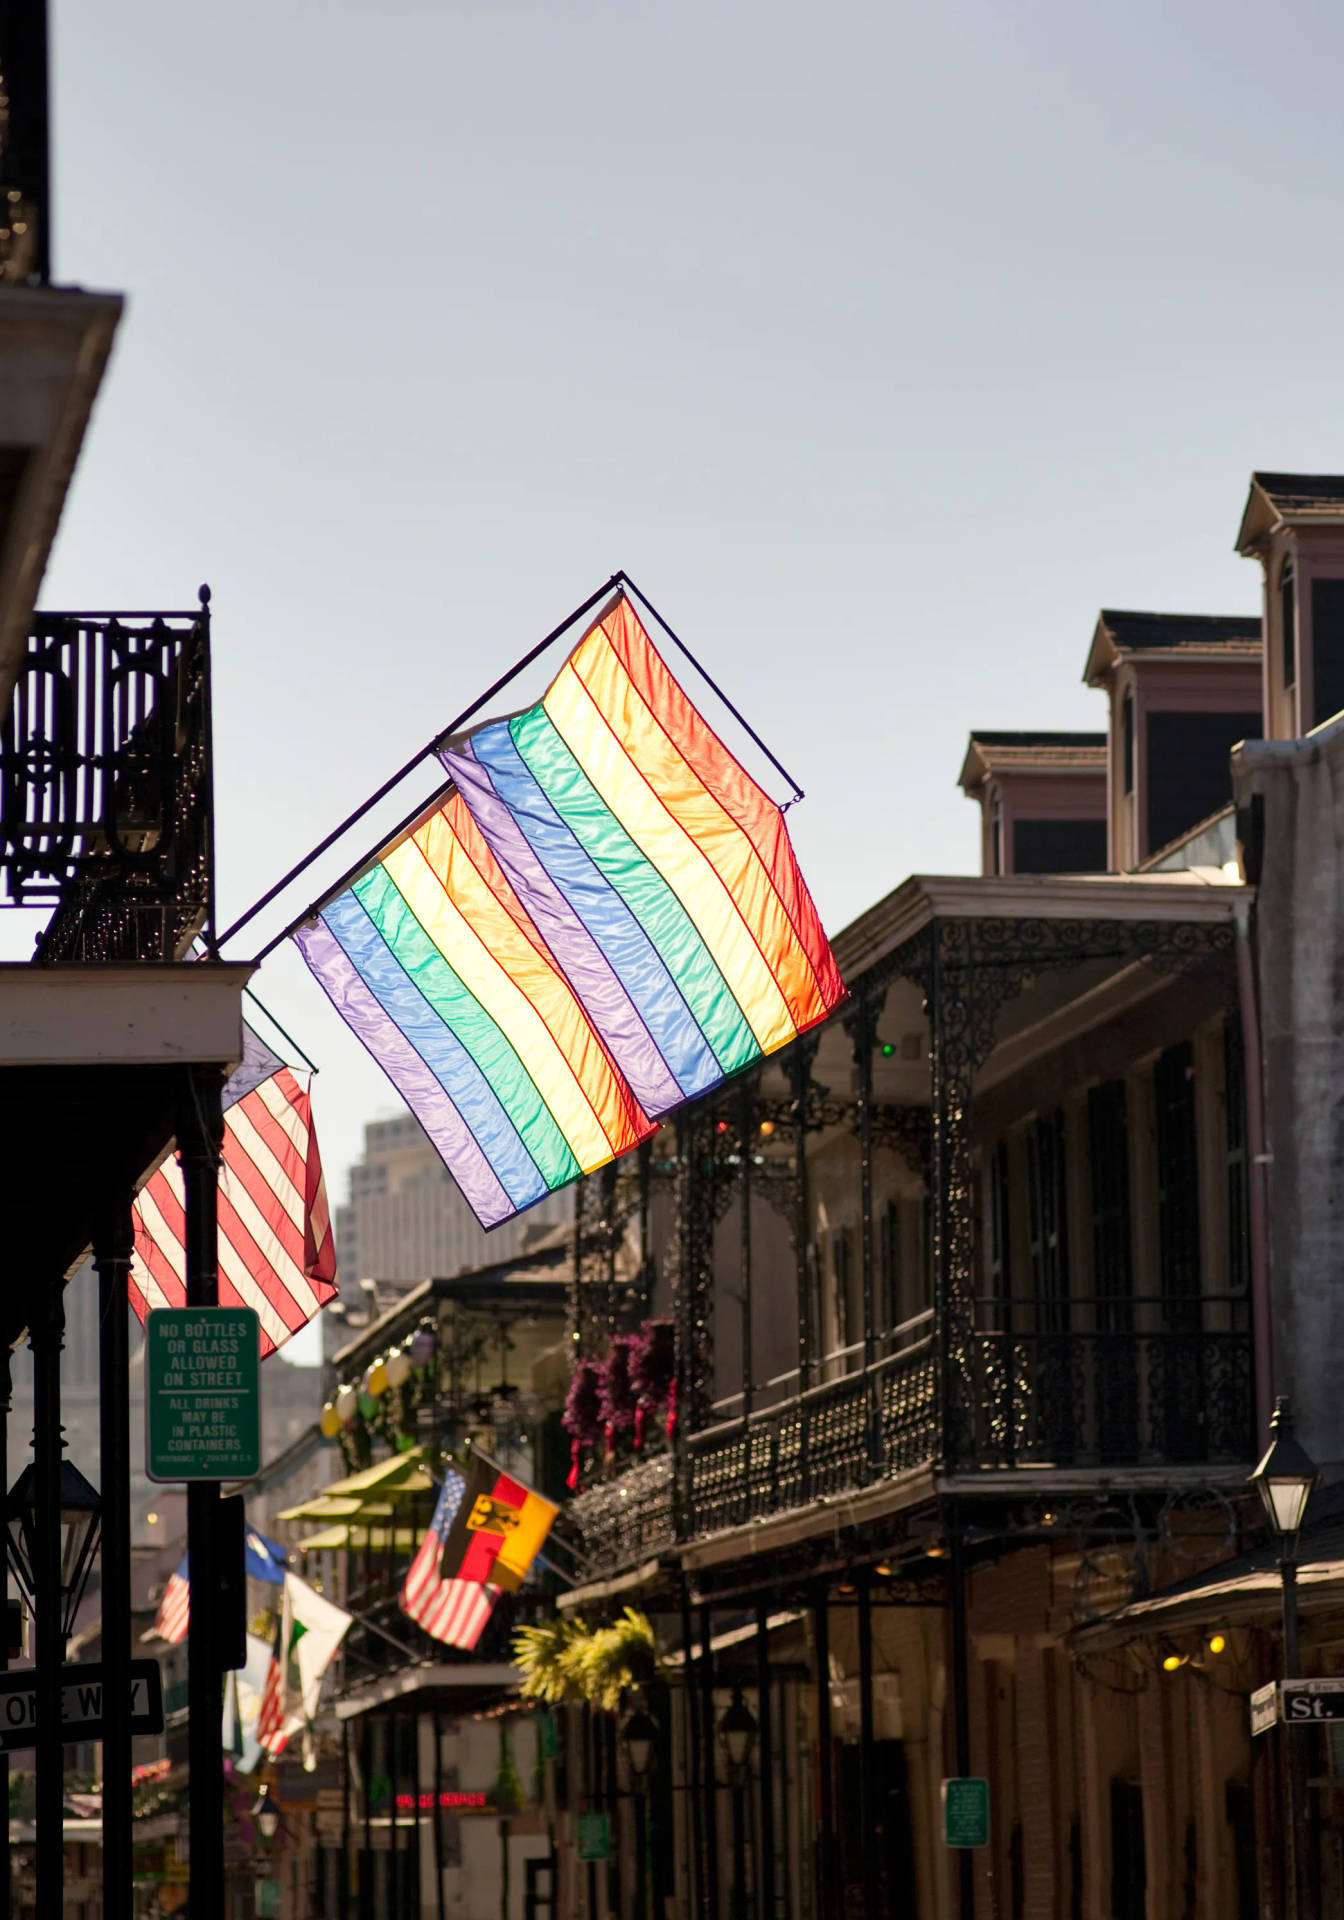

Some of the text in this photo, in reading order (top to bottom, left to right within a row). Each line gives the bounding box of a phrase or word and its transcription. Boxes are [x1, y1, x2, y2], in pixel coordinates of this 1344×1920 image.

[159, 1323, 247, 1337] NO BOTTLES
[168, 1339, 239, 1354] OR GLASS
[171, 1355, 237, 1370] ALLOWED
[164, 1371, 243, 1386] ON STREET
[170, 1397, 239, 1410] ALL DRINKS
[182, 1411, 227, 1423] MAY BE
[172, 1425, 237, 1437] IN PLASTIC
[168, 1439, 242, 1452] CONTAINERS
[78, 1683, 140, 1717] WY
[1291, 1696, 1334, 1719] St.
